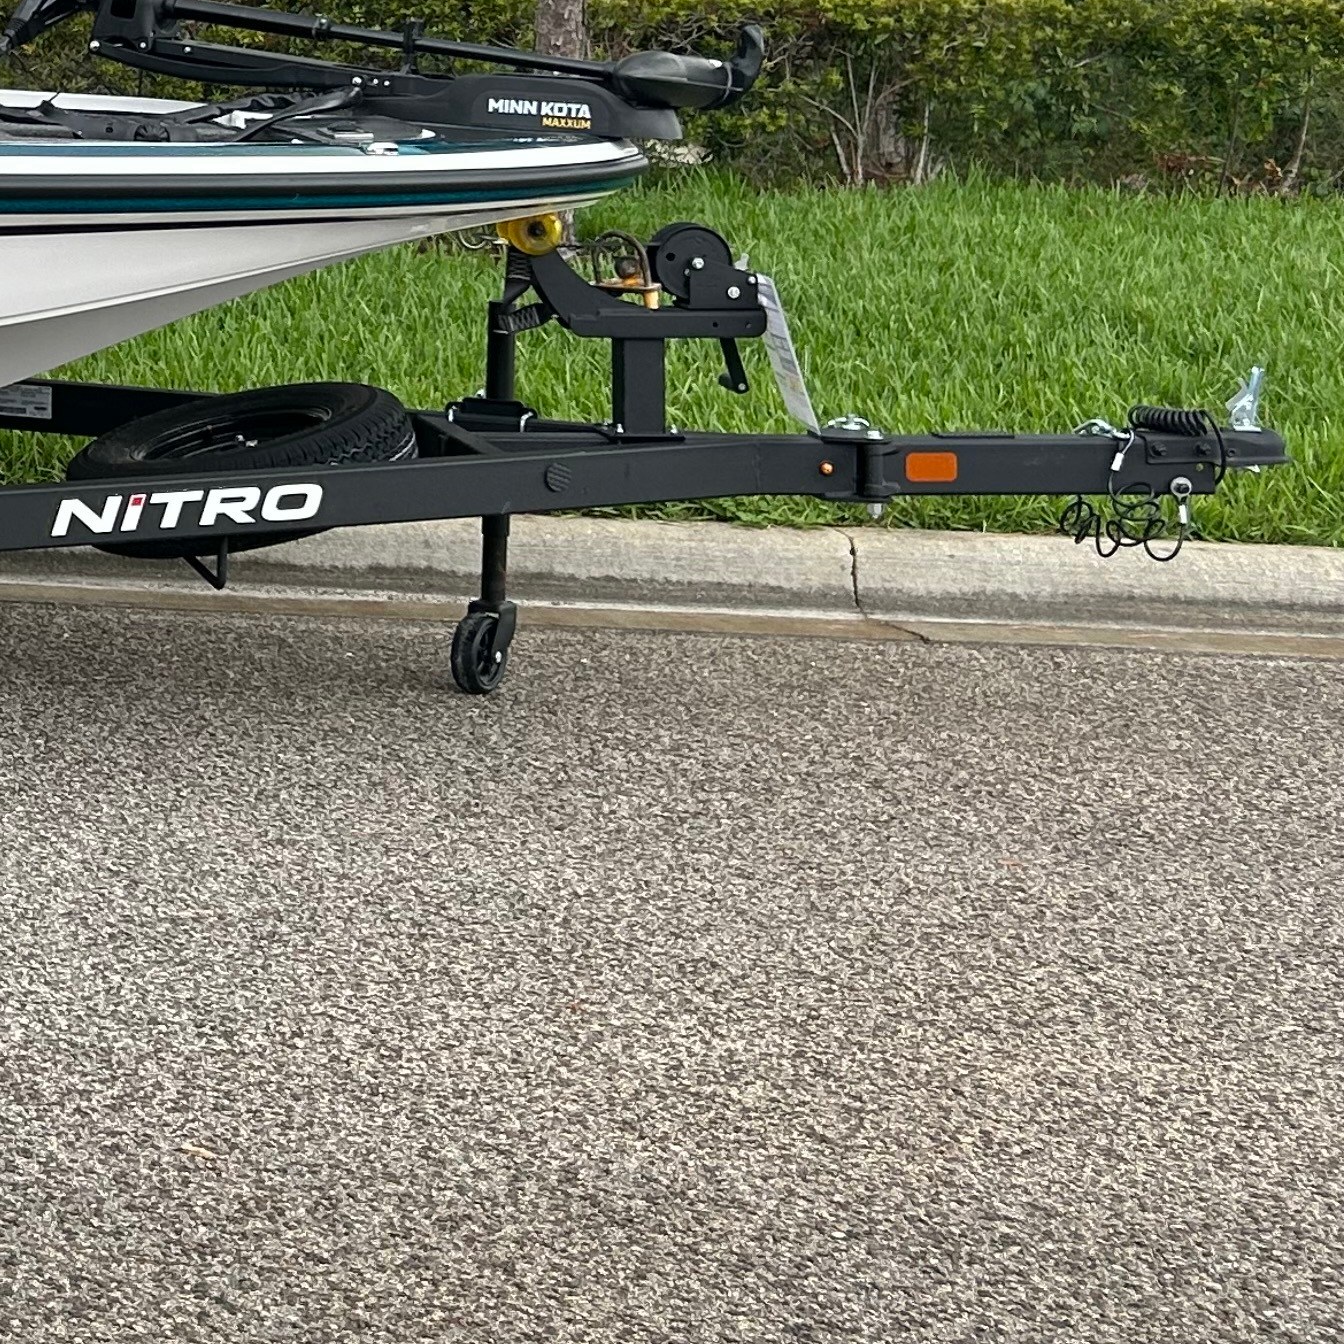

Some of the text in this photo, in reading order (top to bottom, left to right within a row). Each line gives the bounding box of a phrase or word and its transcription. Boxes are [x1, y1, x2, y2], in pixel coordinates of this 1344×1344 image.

[488, 98, 592, 119] MINN KOTA
[542, 117, 592, 130] MAXXUM
